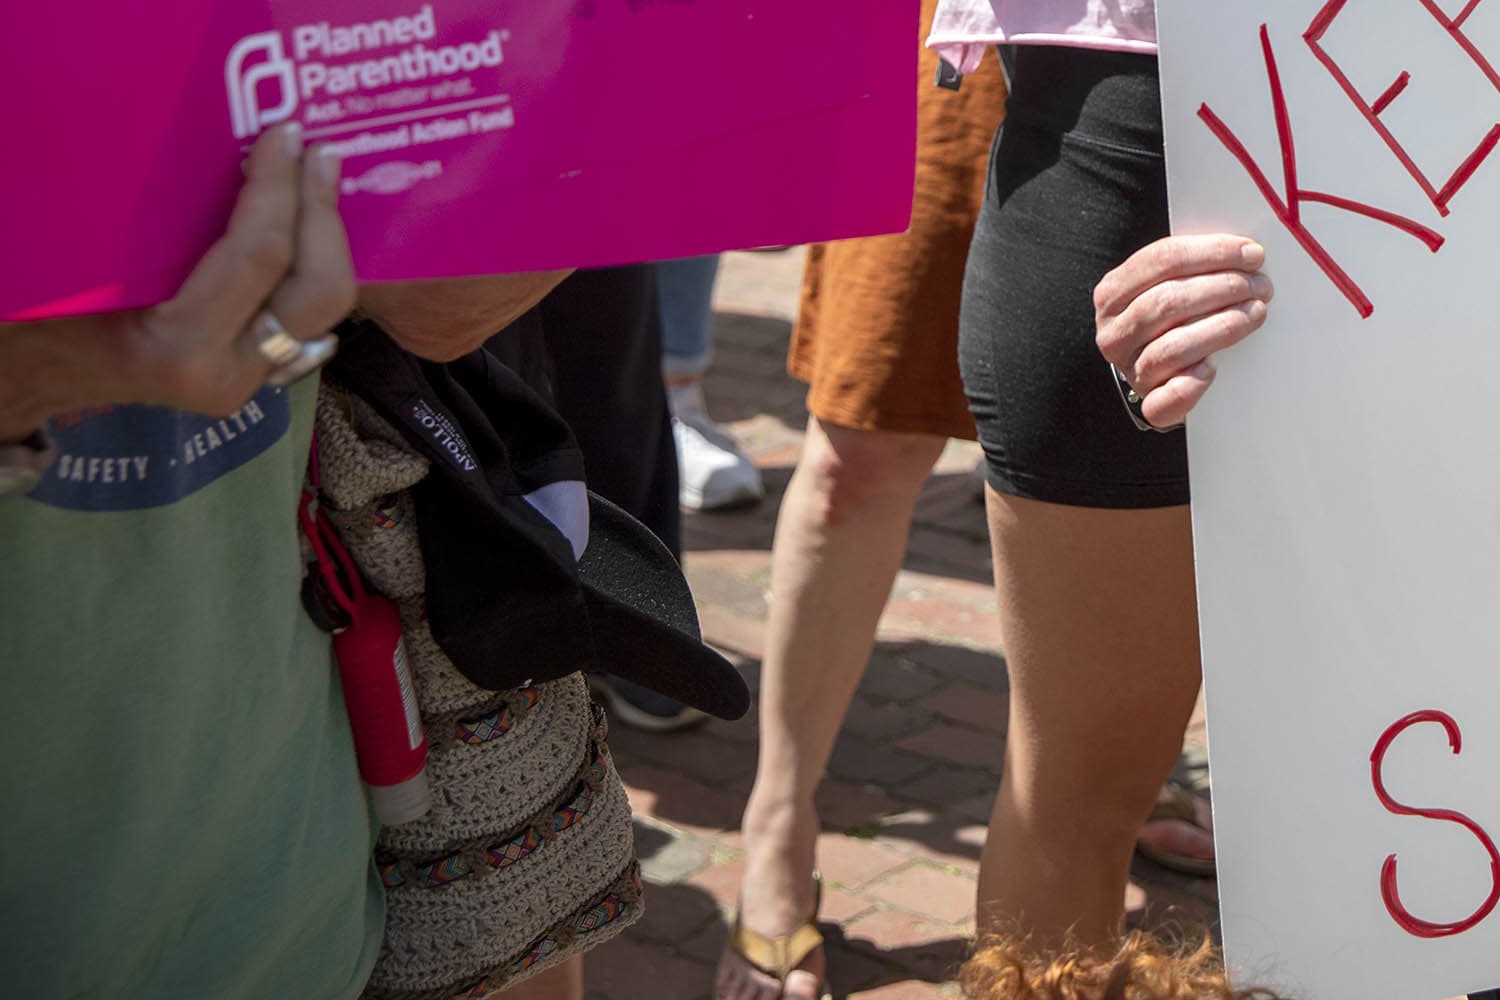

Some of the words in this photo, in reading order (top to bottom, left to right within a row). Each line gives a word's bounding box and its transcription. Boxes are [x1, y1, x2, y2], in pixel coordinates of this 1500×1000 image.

[293, 3, 436, 60] Planned
[300, 29, 504, 99] Parenthood
[57, 454, 149, 484] SAFETY
